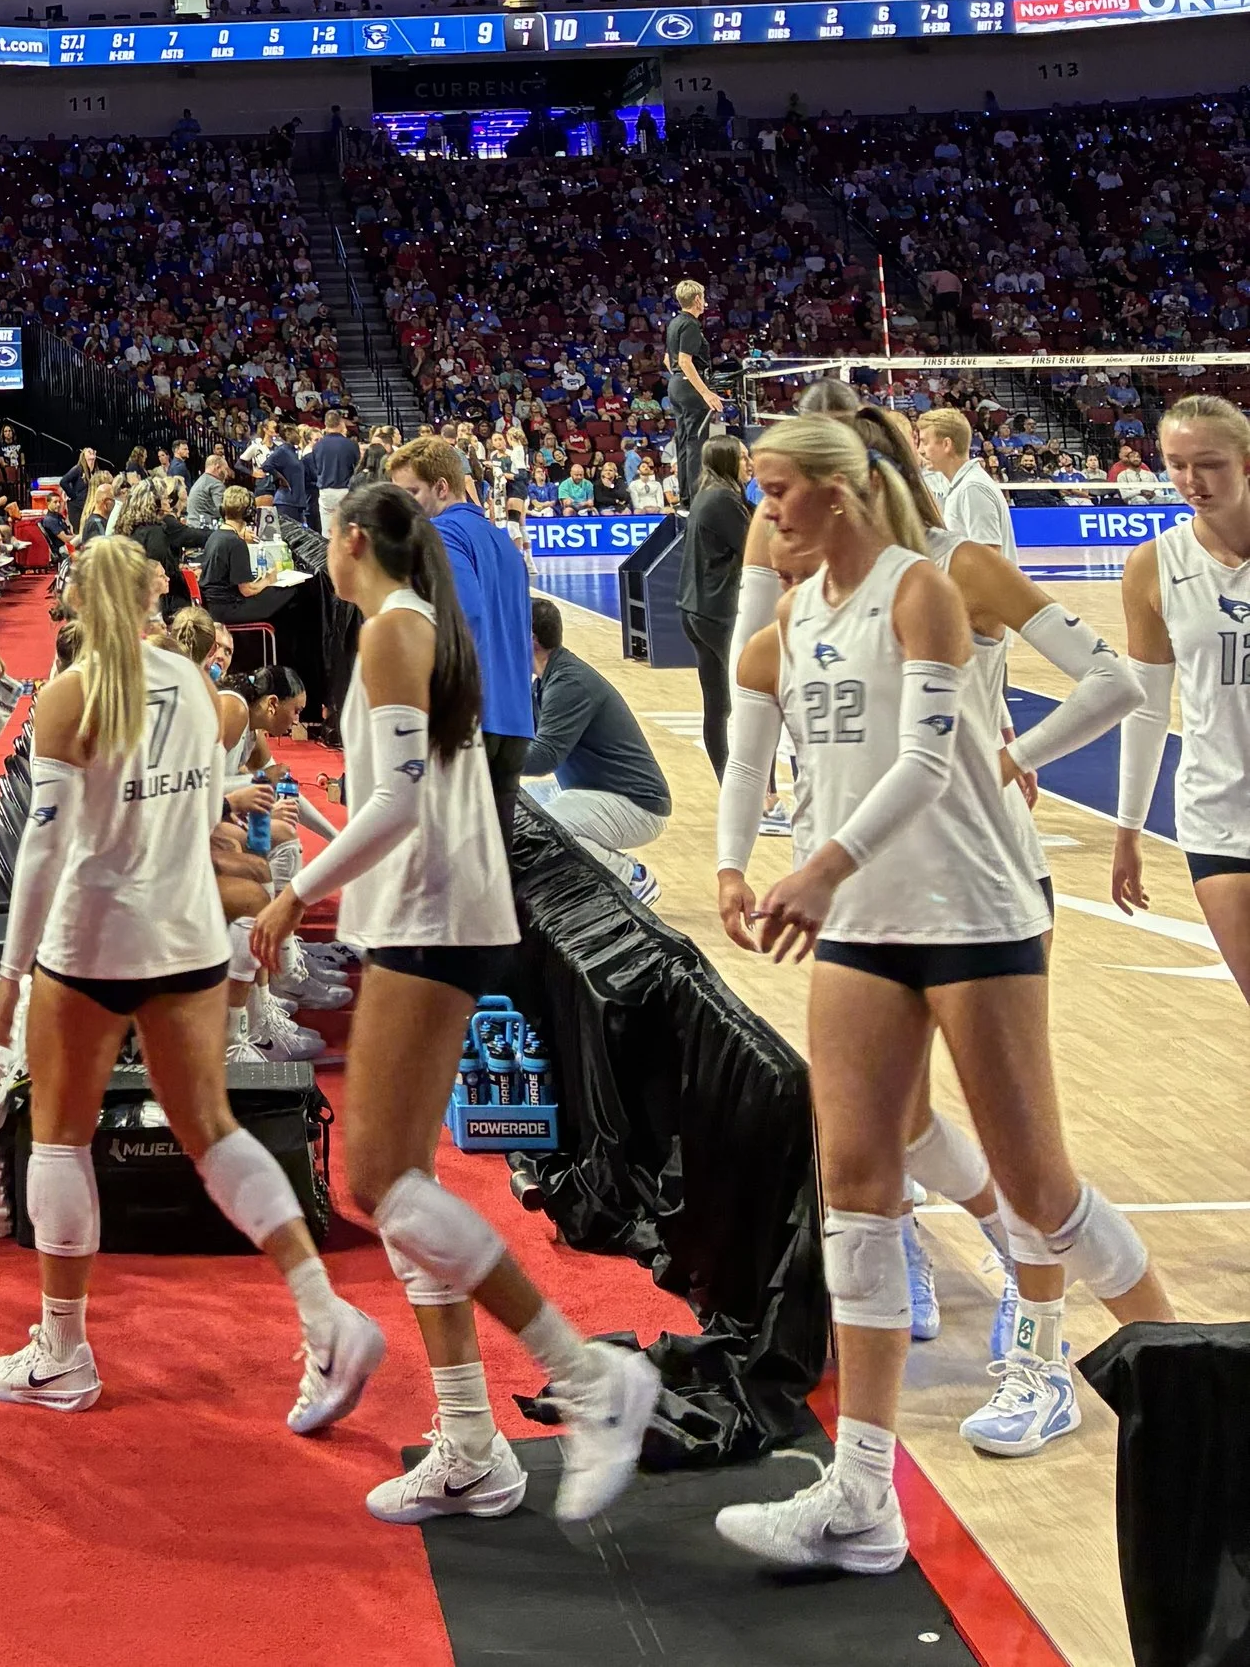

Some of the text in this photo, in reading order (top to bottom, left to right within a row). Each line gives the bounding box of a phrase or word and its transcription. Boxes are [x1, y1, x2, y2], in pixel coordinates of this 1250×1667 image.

[827, 8, 838, 24] 2
[878, 6, 889, 22] 6
[921, 4, 948, 20] 7-0
[970, 1, 1004, 18] 53.8
[1020, 2, 1058, 17] Now
[514, 18, 535, 30] SET
[607, 16, 614, 29] 1
[713, 12, 741, 29] 0-0
[774, 9, 785, 26] 4
[433, 22, 440, 36] 1
[478, 22, 493, 44] 9
[554, 19, 578, 42] 10
[872, 24, 896, 36] ASTS
[923, 23, 950, 34] K-ERR
[977, 20, 993, 32] HIT
[112, 32, 134, 48] 8-1
[169, 31, 178, 46] 7
[219, 29, 229, 45] 0
[269, 28, 280, 43] 5
[312, 26, 336, 42] 1-2
[522, 32, 529, 46] 1
[604, 31, 621, 42] TOL
[713, 30, 740, 42] A-ERR
[768, 28, 790, 40] DIGS
[60, 34, 85, 50] 57.1
[311, 43, 338, 55] A-ERR
[60, 52, 76, 63] HIT
[109, 50, 134, 61] K-ERR
[161, 48, 183, 60] ASTS
[211, 46, 234, 58] BLKS
[262, 45, 284, 56] DIGS
[1038, 62, 1079, 79] 113
[674, 78, 712, 92] 112
[69, 96, 106, 111] 111
[923, 354, 1196, 366] FIRST SERVE FIRST SERVE FIRST SERVE
[1080, 513, 1165, 538] FIRST
[803, 680, 865, 744] 22
[145, 686, 178, 770] 7
[123, 766, 211, 803] BLUEJAYS
[470, 1122, 546, 1135] POWERADE
